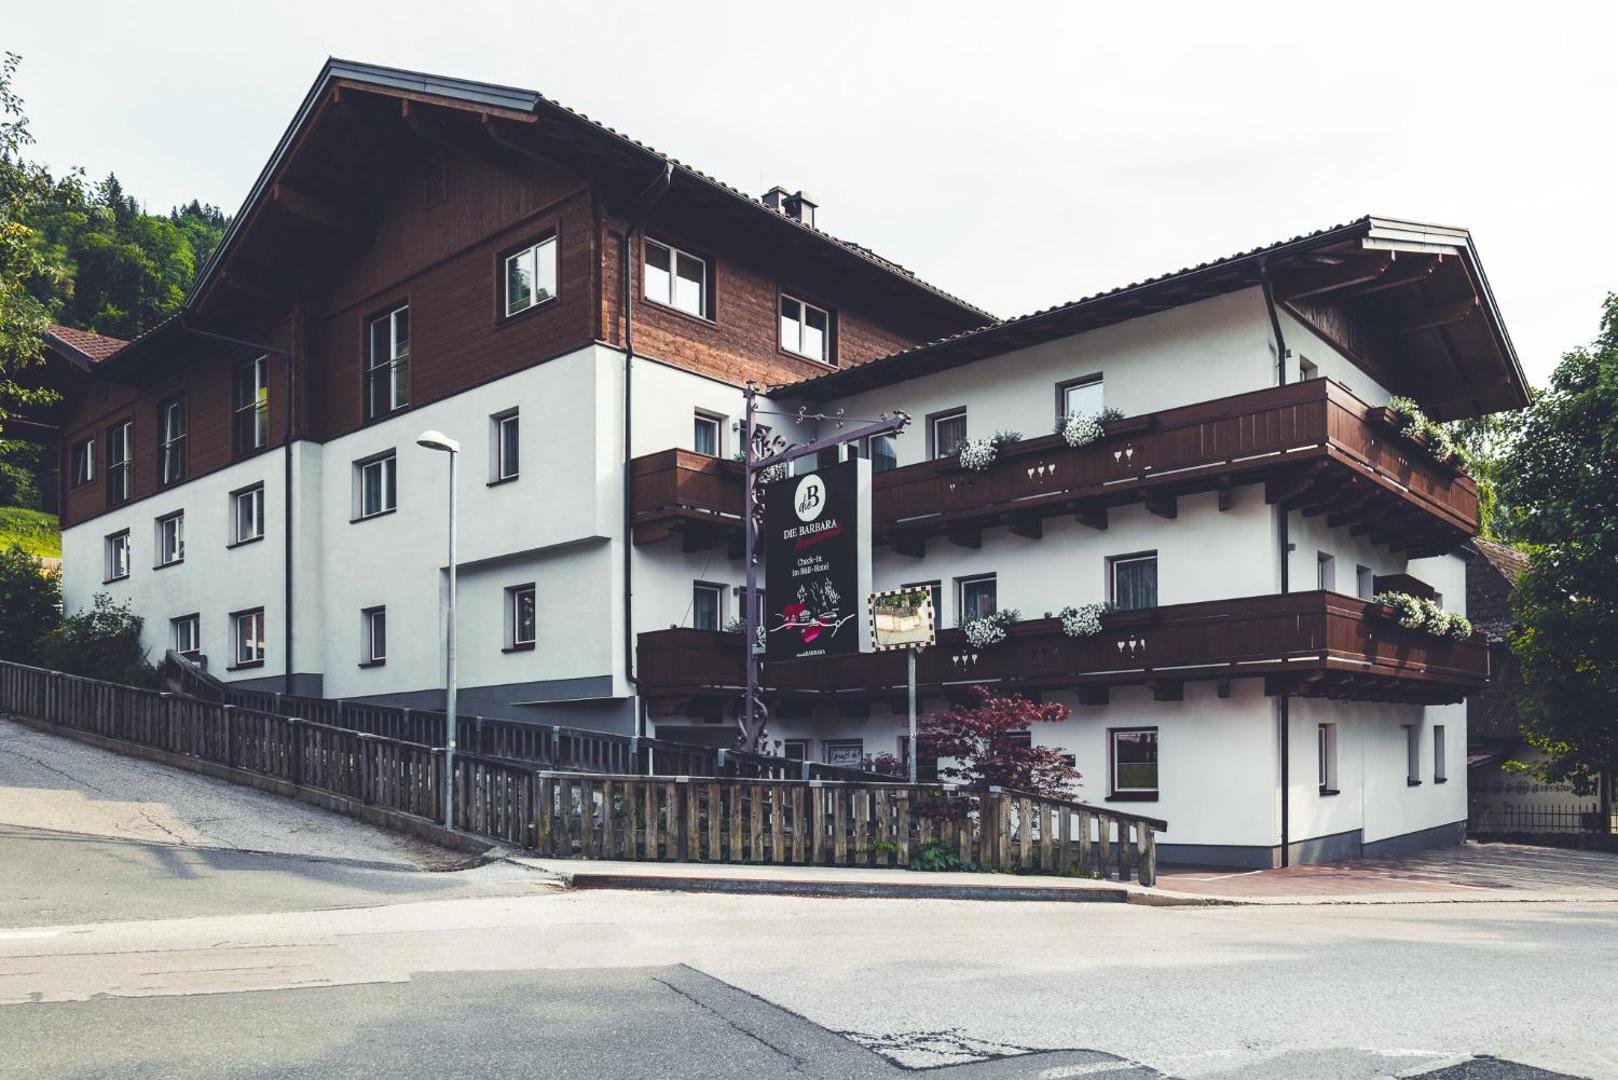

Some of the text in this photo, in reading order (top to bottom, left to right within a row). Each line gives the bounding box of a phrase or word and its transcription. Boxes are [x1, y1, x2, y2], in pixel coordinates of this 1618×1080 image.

[799, 485, 820, 513] die B
[783, 528, 798, 540] DIE
[799, 519, 837, 536] BARBARA
